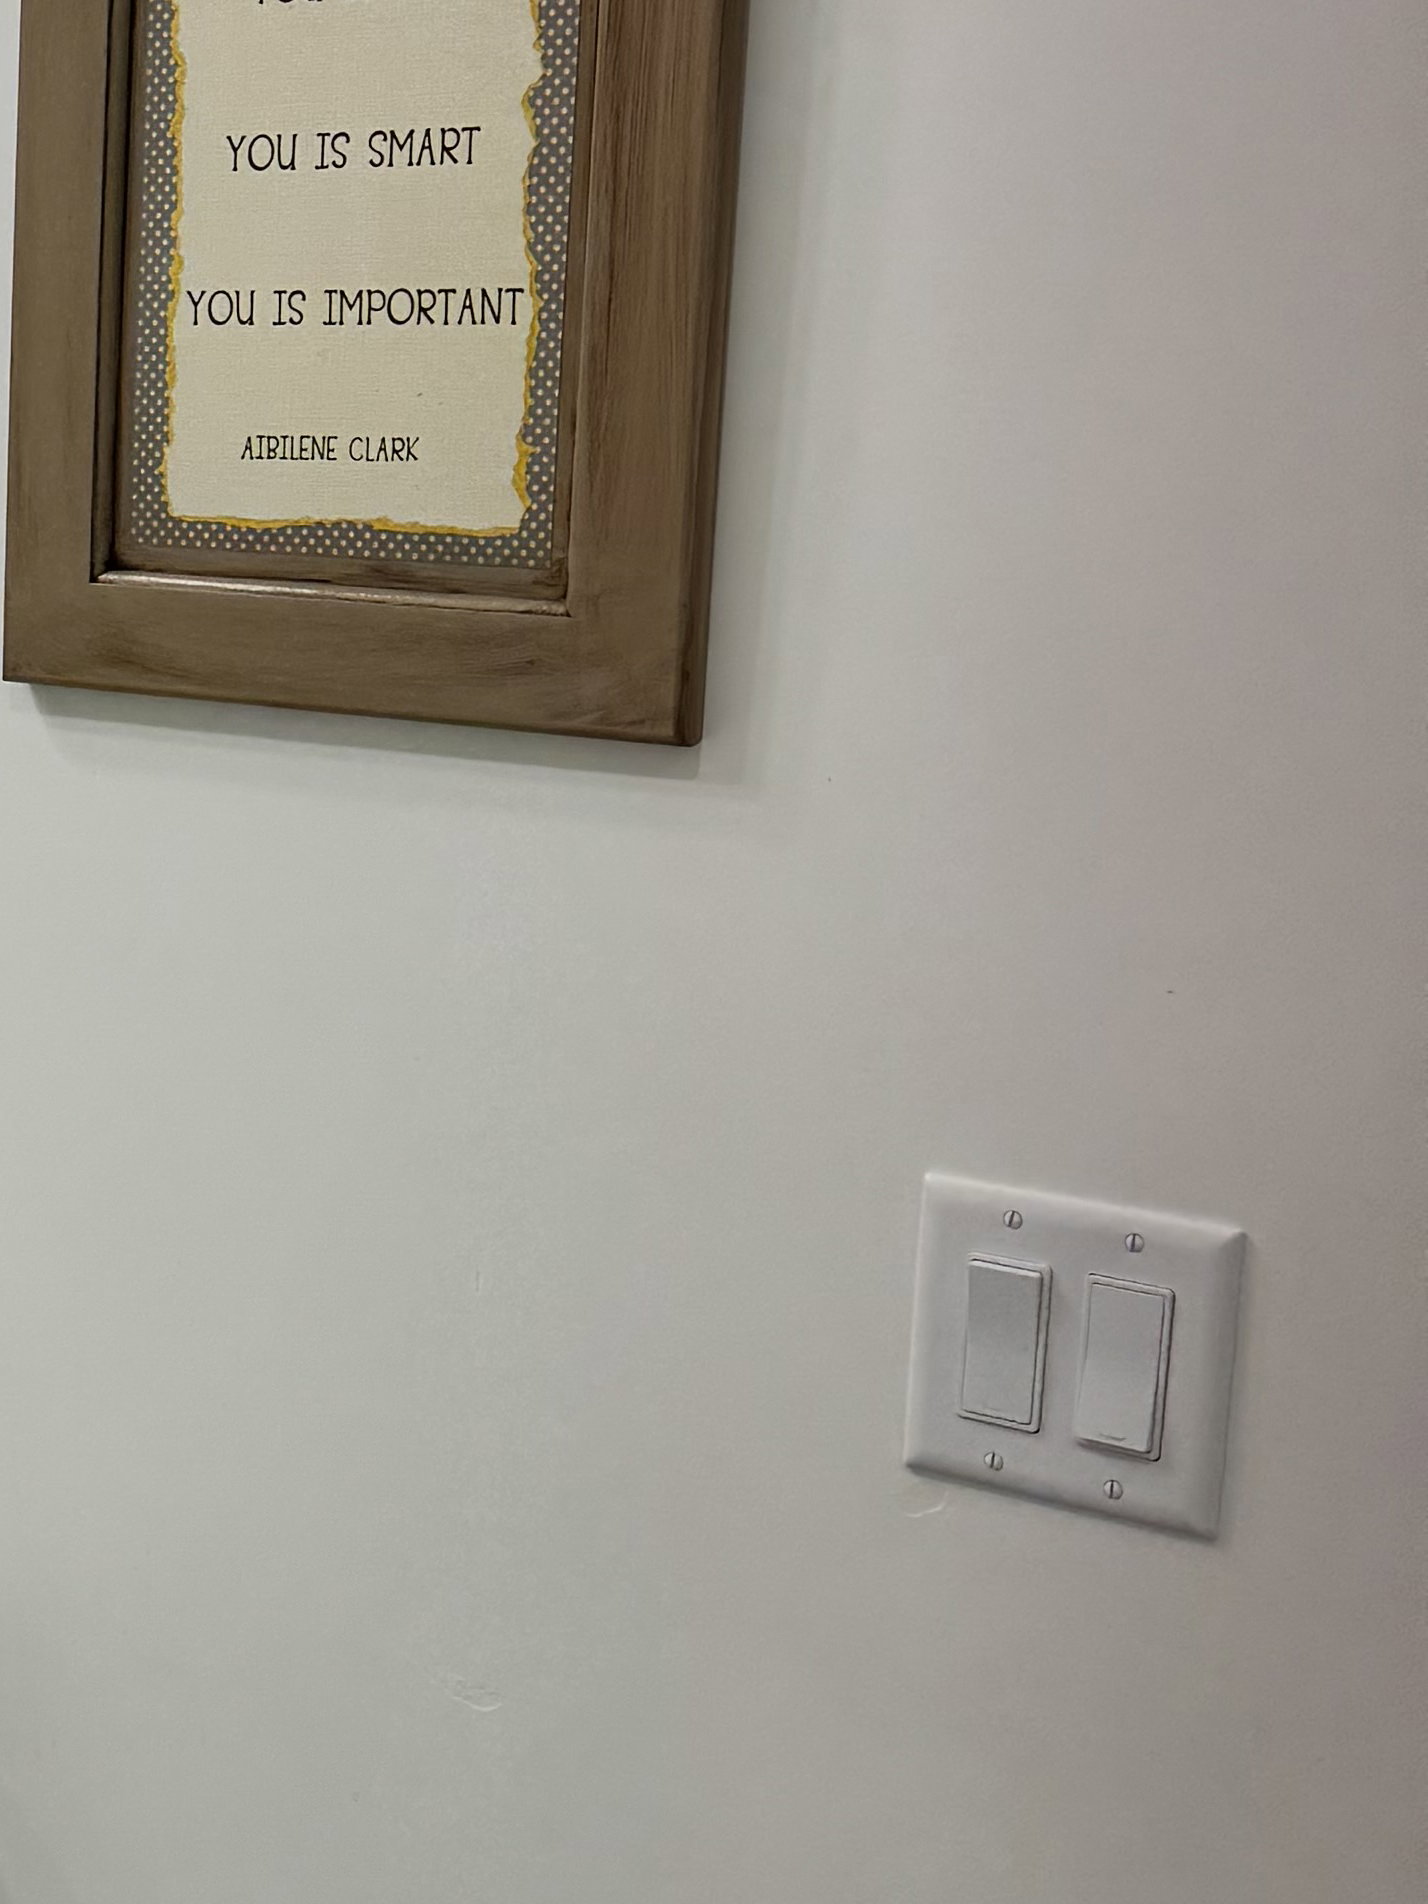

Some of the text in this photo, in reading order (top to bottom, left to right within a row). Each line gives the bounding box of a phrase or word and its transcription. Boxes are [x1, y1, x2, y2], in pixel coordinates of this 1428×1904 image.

[225, 125, 482, 173] YOU IS SMART
[185, 287, 525, 327] YOU IS IMPORTANT
[240, 434, 420, 463] AIBILENE CLARK
